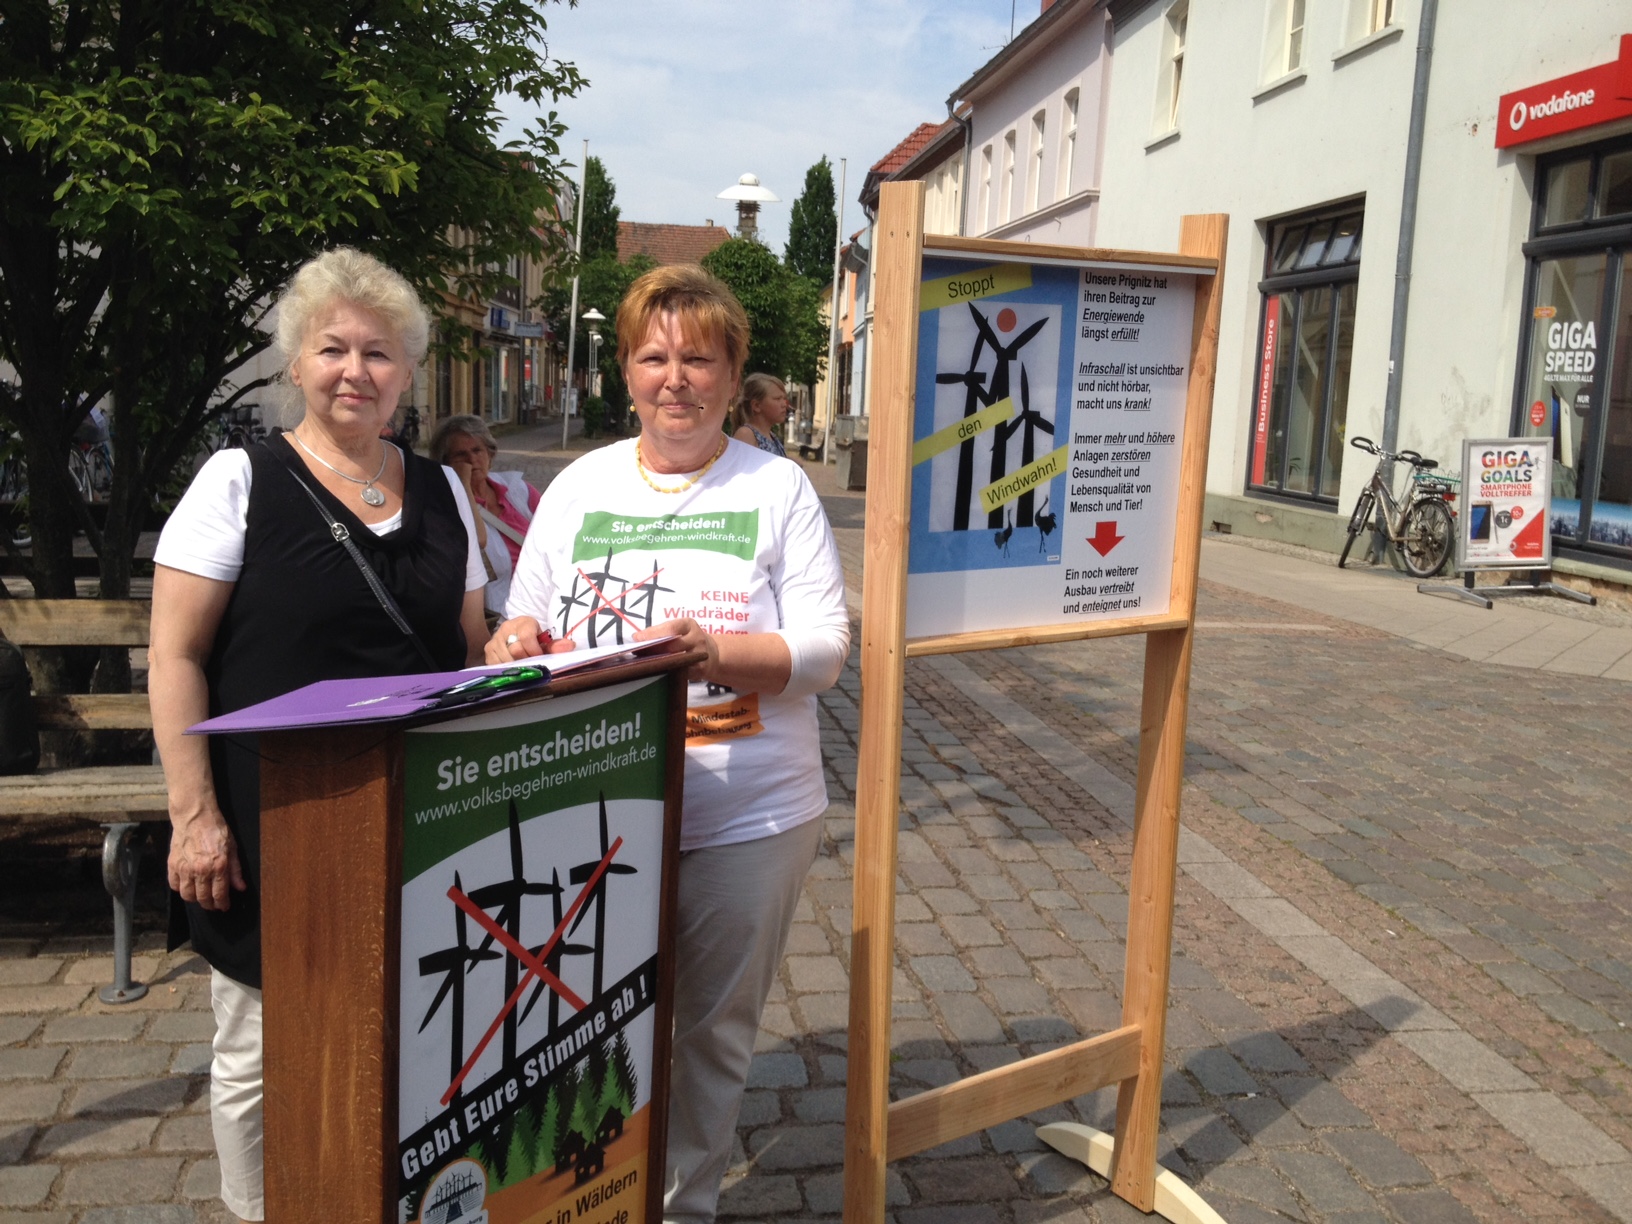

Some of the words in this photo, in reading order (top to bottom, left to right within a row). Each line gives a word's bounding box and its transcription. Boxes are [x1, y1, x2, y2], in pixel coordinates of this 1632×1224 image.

[1529, 88, 1596, 120] vodafone
[948, 275, 995, 299] Stoppt
[1085, 272, 1117, 286] Unsere
[1119, 275, 1152, 290] Prignitz
[1153, 277, 1167, 289] hat
[1084, 290, 1106, 303] ihren
[1109, 292, 1140, 307] Beitrag
[1141, 296, 1156, 306] zur
[1082, 308, 1145, 323] Energiewende
[1081, 326, 1109, 341] längst
[1111, 328, 1139, 341] erfüllt!
[1548, 321, 1597, 349] GIGA
[1079, 362, 1125, 375] Infraschall
[1127, 363, 1137, 375] ist
[1139, 364, 1184, 376] unsichtbar
[1545, 351, 1595, 372] SPEED
[1258, 363, 1270, 432] Business
[1264, 319, 1274, 360] Store
[1078, 380, 1096, 392] und
[1097, 380, 1119, 393] nicht
[1121, 381, 1151, 395] hörbar,
[1077, 398, 1104, 410] macht
[1106, 400, 1122, 410] uns
[1124, 398, 1151, 410] krank!
[958, 418, 982, 439] den
[1074, 432, 1102, 445] Immer
[1104, 432, 1126, 444] mehr
[1128, 432, 1144, 444] und
[1146, 432, 1175, 444] höhere
[1073, 450, 1109, 463] Anlagen
[1111, 449, 1151, 462] zerstören
[1481, 450, 1533, 468] GIGA
[1072, 466, 1122, 479] Gesundheit
[1123, 466, 1140, 478] und
[1481, 469, 1532, 483] GOALS
[986, 458, 1058, 505] Windwahn!
[1481, 483, 1532, 491] SMARTPHONE
[1071, 483, 1134, 498] Lebensqualität
[1136, 484, 1151, 494] von
[1481, 490, 1532, 498] VOLLTREFFER
[1070, 500, 1104, 513] Mensch
[1105, 500, 1122, 512] und
[1124, 499, 1142, 511] Tier!
[611, 521, 633, 533] Sie
[636, 518, 725, 532] entscheiden!
[582, 531, 751, 545] www.volksbegehren-windkraft.de
[1065, 569, 1080, 581] Ein
[1081, 567, 1103, 579] noch
[1105, 566, 1139, 578] weiterer
[701, 590, 749, 604] KEINE
[1064, 584, 1097, 597] Ausbau
[1099, 582, 1134, 594] vertreibt
[1063, 601, 1079, 614] und
[1081, 599, 1121, 613] enteignet
[1123, 597, 1141, 609] uns!
[663, 606, 749, 622] Windräder
[686, 721, 752, 738] ohnbebauung
[436, 756, 479, 790] Sie
[487, 712, 641, 777] entscheiden!
[415, 742, 657, 824] www.volksbegehren-windkraft.de
[401, 1116, 462, 1180] Gebt
[464, 1078, 519, 1134] Eure
[523, 1010, 606, 1087] Stimme
[611, 986, 635, 1021] ab
[576, 1170, 637, 1217] Wäldern
